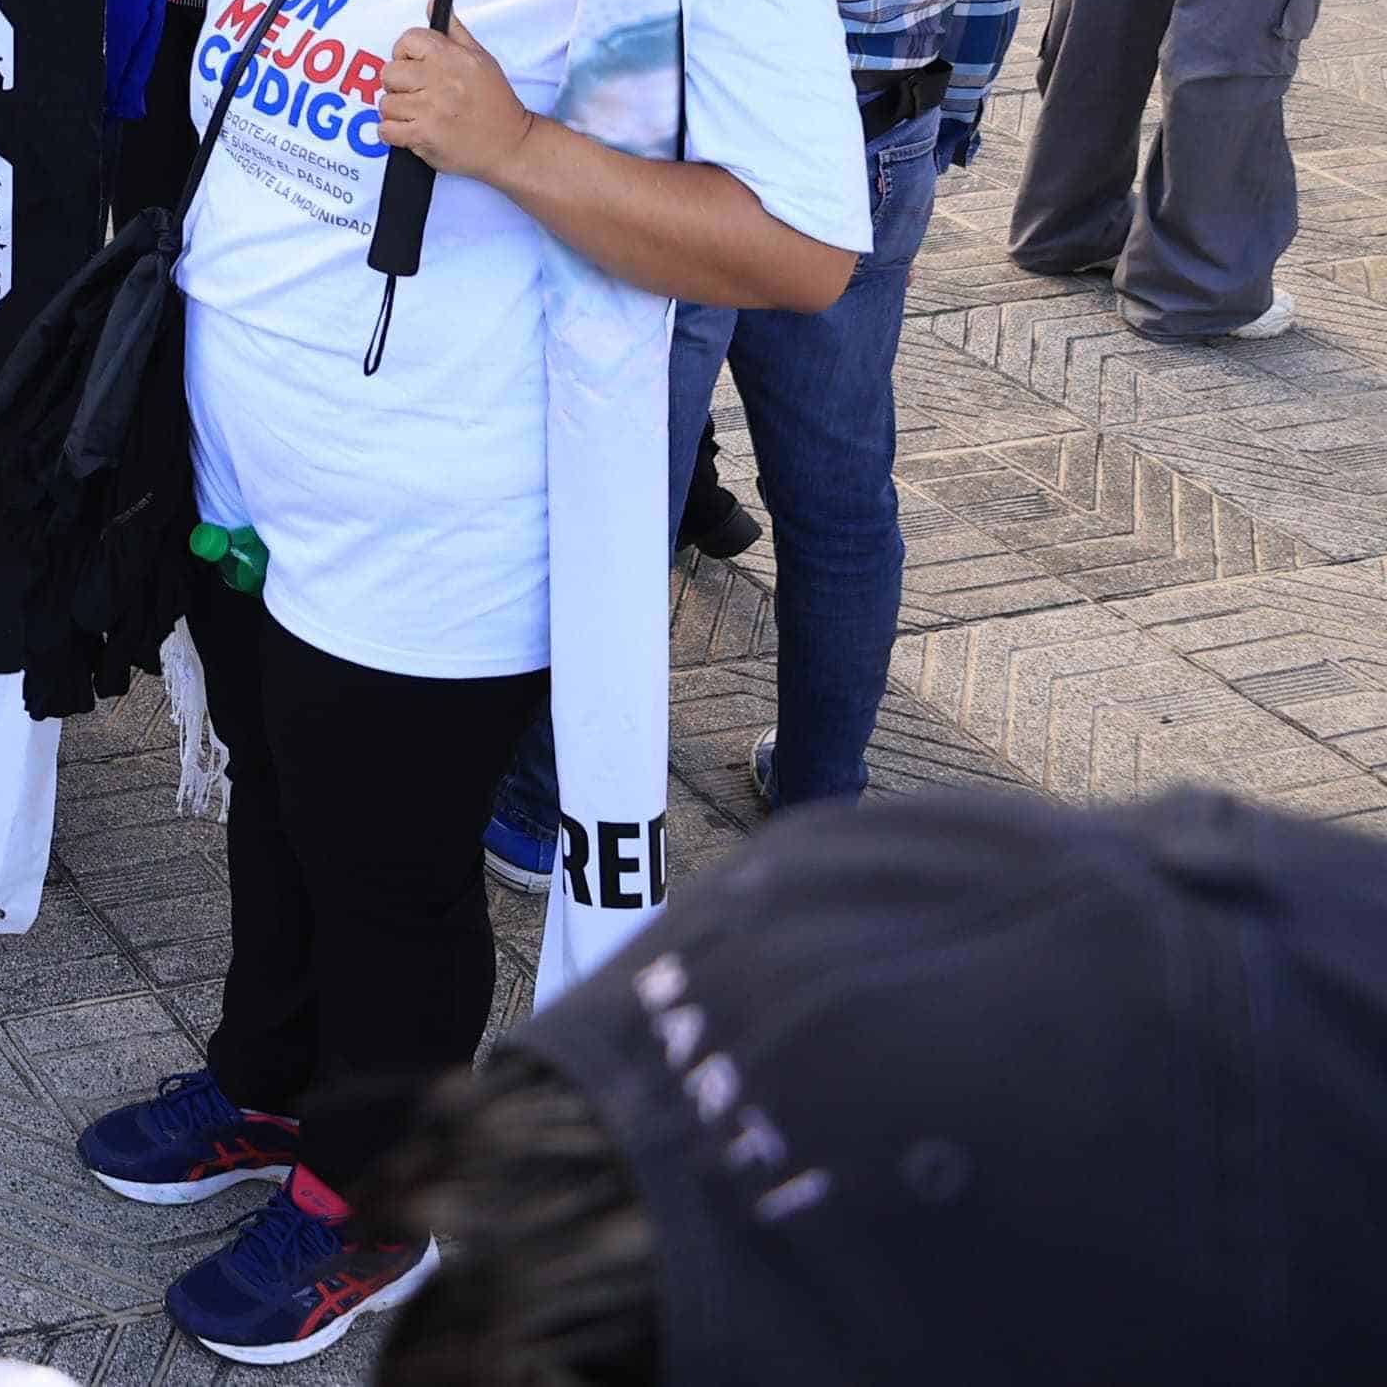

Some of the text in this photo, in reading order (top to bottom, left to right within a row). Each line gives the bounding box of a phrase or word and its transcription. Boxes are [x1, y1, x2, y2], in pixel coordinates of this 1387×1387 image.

[280, 139, 360, 182] DERECHOS
[297, 169, 354, 205] PASADO
[290, 190, 373, 237] IMPUNIDAD
